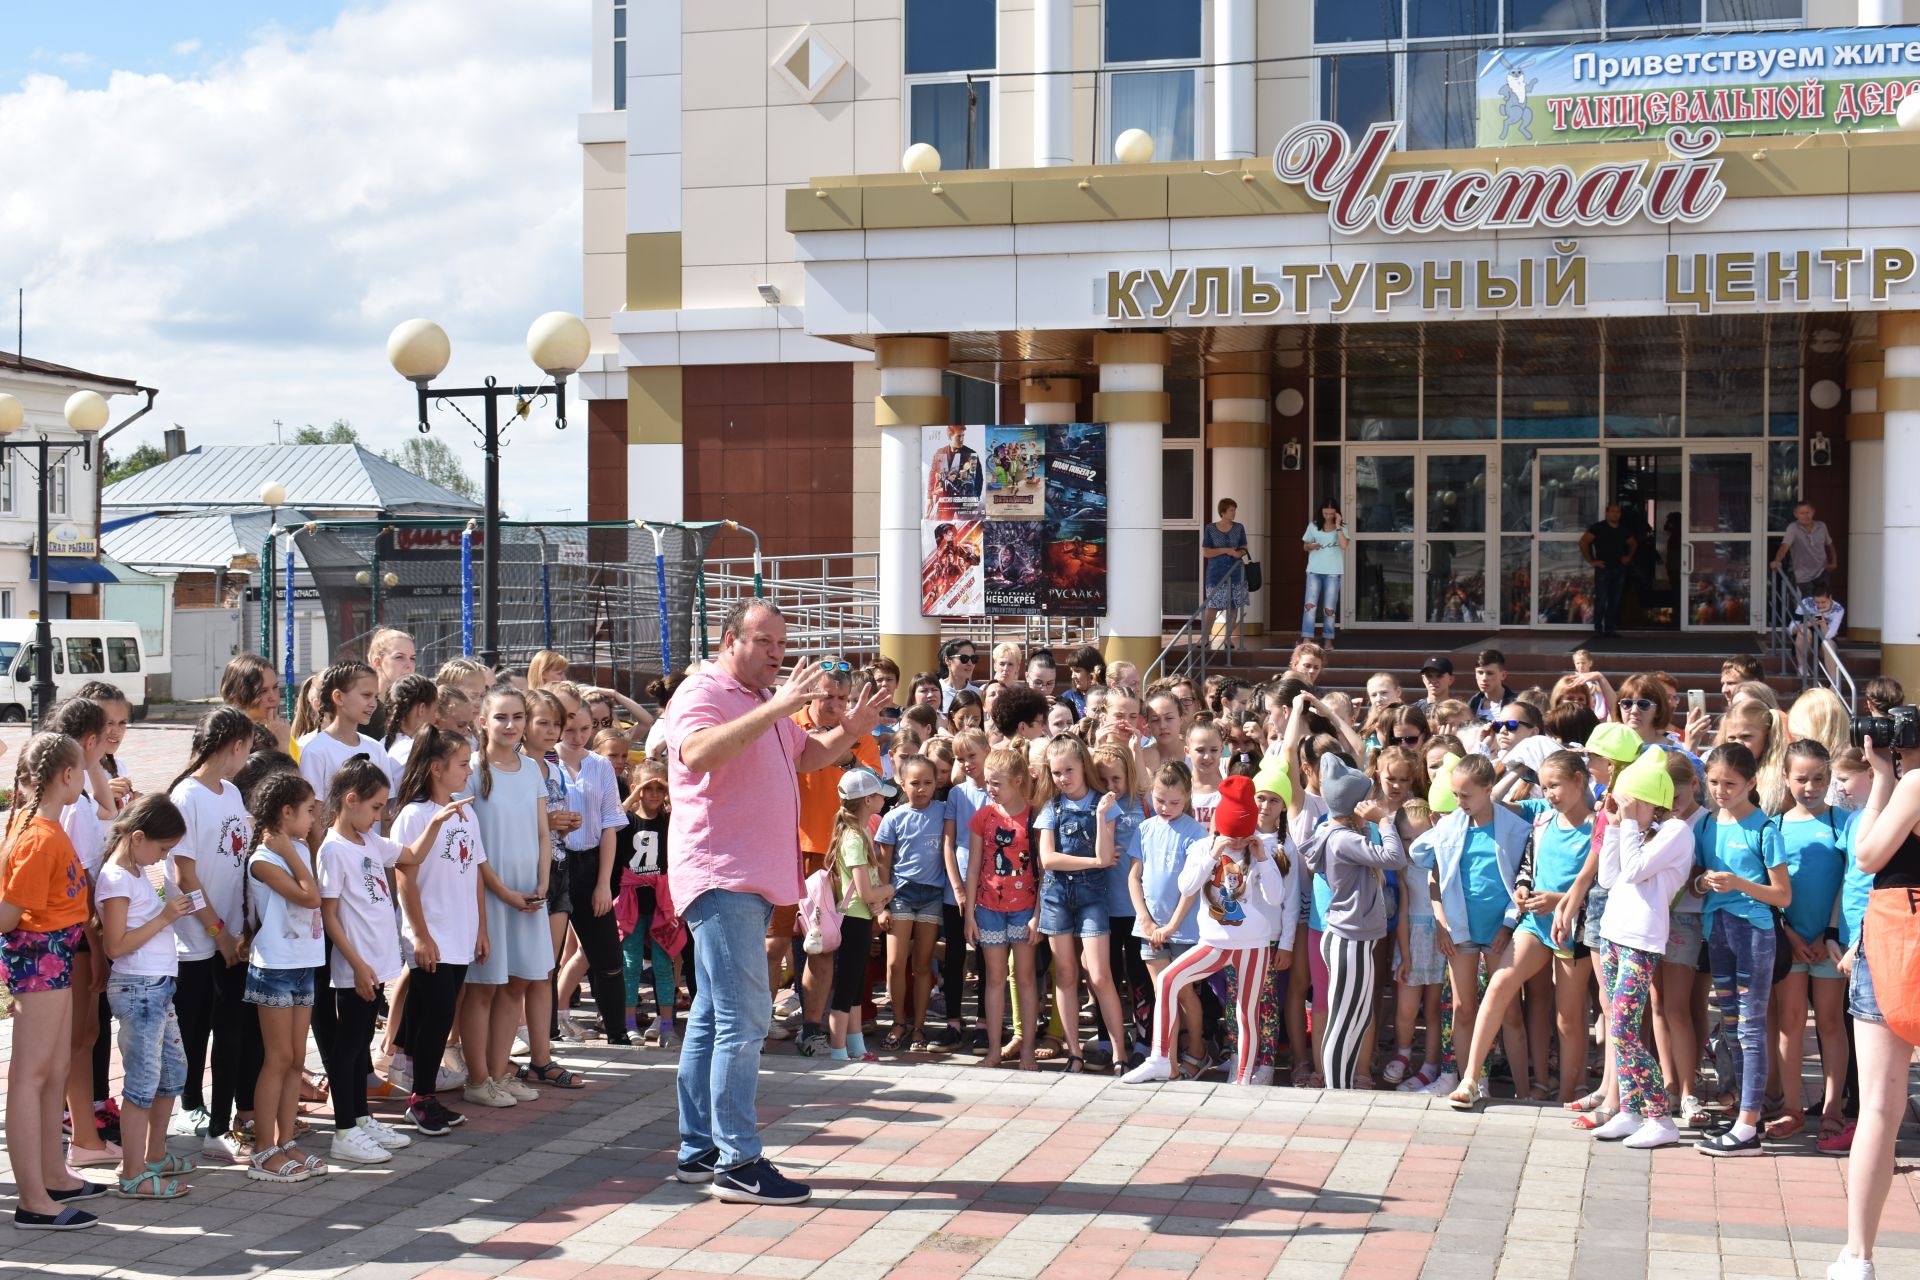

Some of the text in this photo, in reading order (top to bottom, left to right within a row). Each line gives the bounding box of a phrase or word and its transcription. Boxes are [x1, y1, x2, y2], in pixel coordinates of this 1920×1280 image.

[1572, 46, 1825, 85] Приветствуем
[1547, 78, 1825, 134] ТАНЦЕВАЛЬНОЙ
[1273, 120, 1726, 234] Чистай
[1106, 240, 1917, 320] КУЛЬТУРНЫЙ ЦЕНТР
[1087, 470, 1097, 482] 2
[68, 541, 95, 554] РЫБАКА
[1048, 588, 1101, 599] РУСАЛКА
